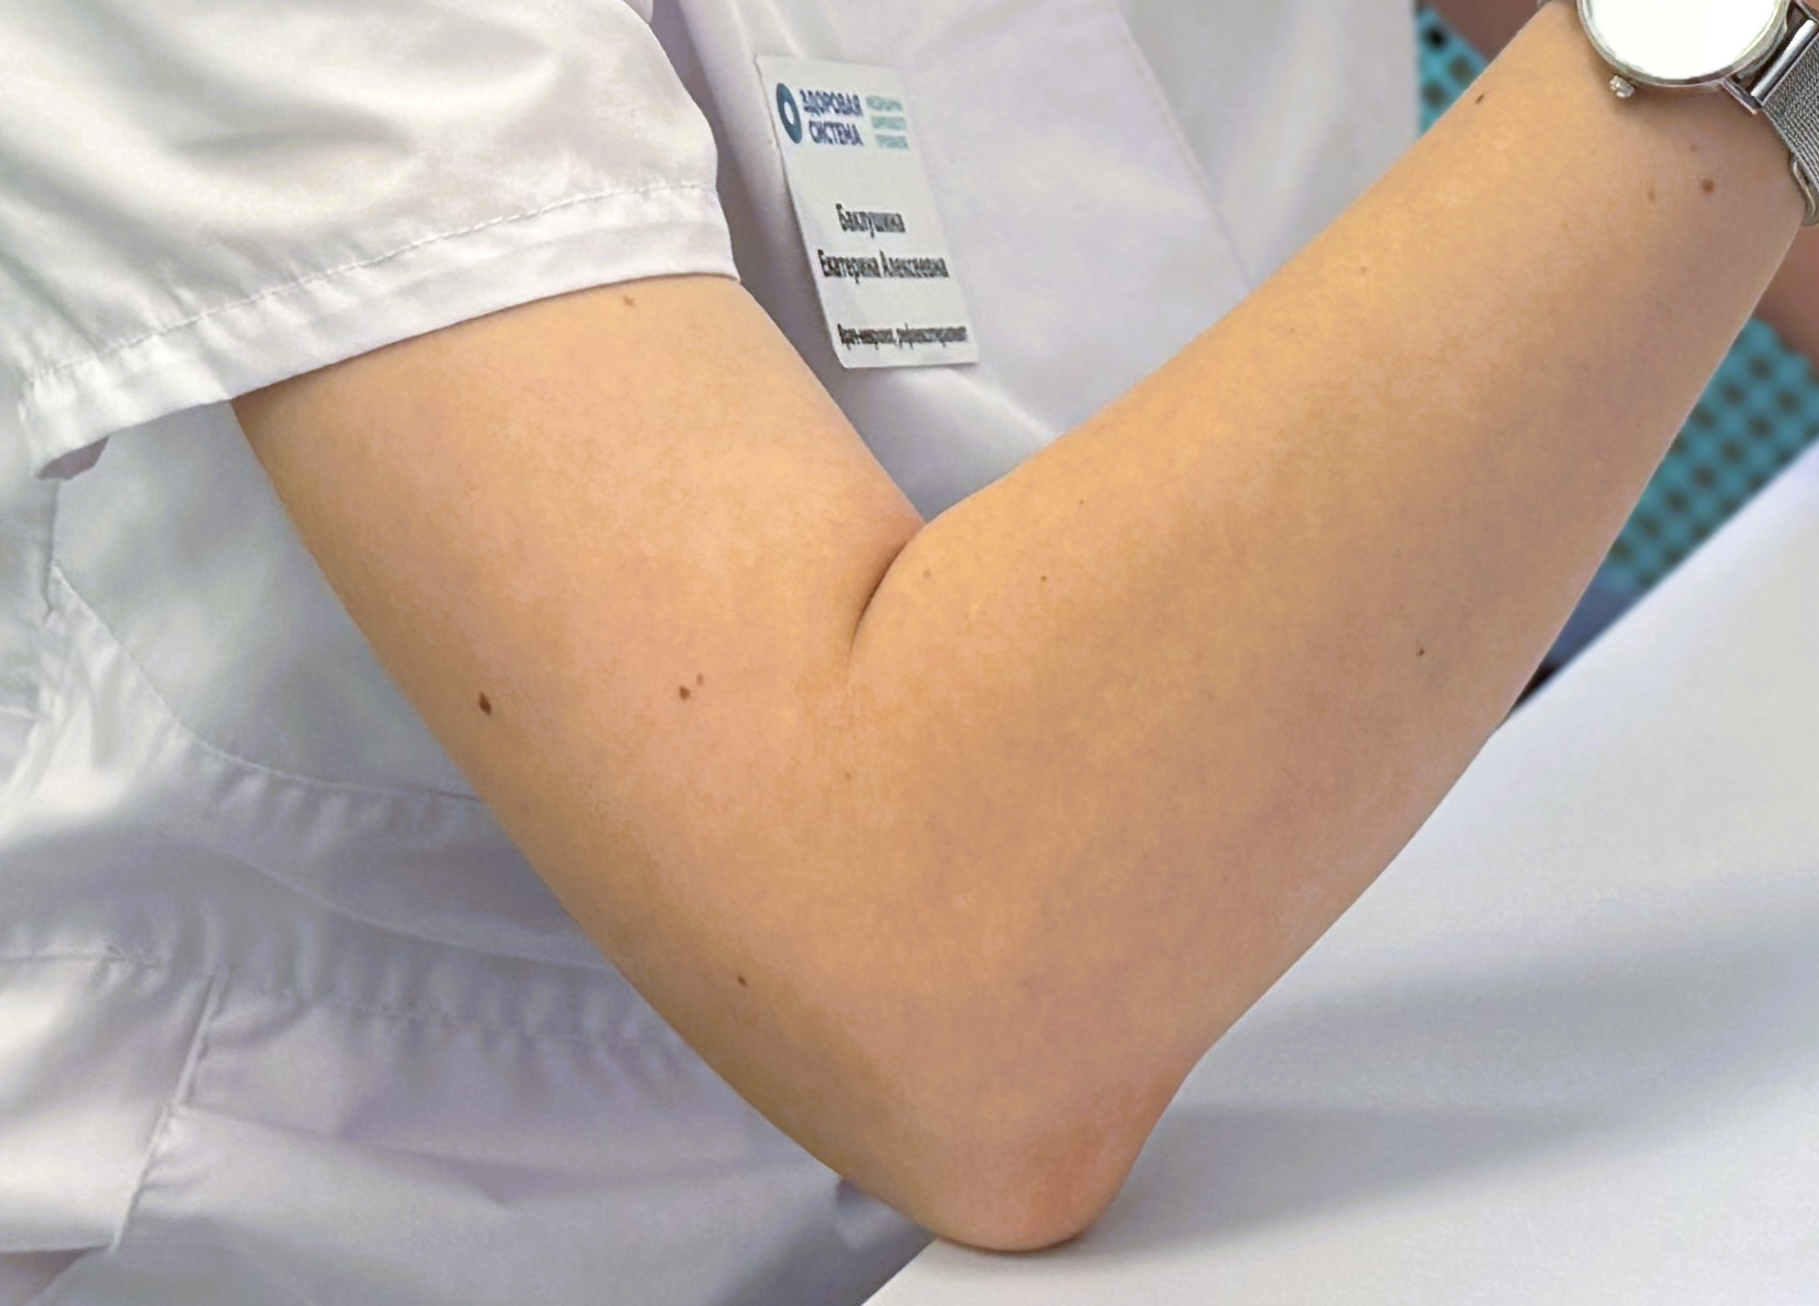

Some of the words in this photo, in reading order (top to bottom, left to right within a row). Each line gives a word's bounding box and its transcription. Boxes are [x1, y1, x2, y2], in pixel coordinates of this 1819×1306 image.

[799, 88, 864, 117] ЗДОРОВАЯ
[808, 119, 865, 146] СИСТЕМА
[817, 248, 881, 285] Екатерина
[879, 249, 950, 278] Алексеевна
